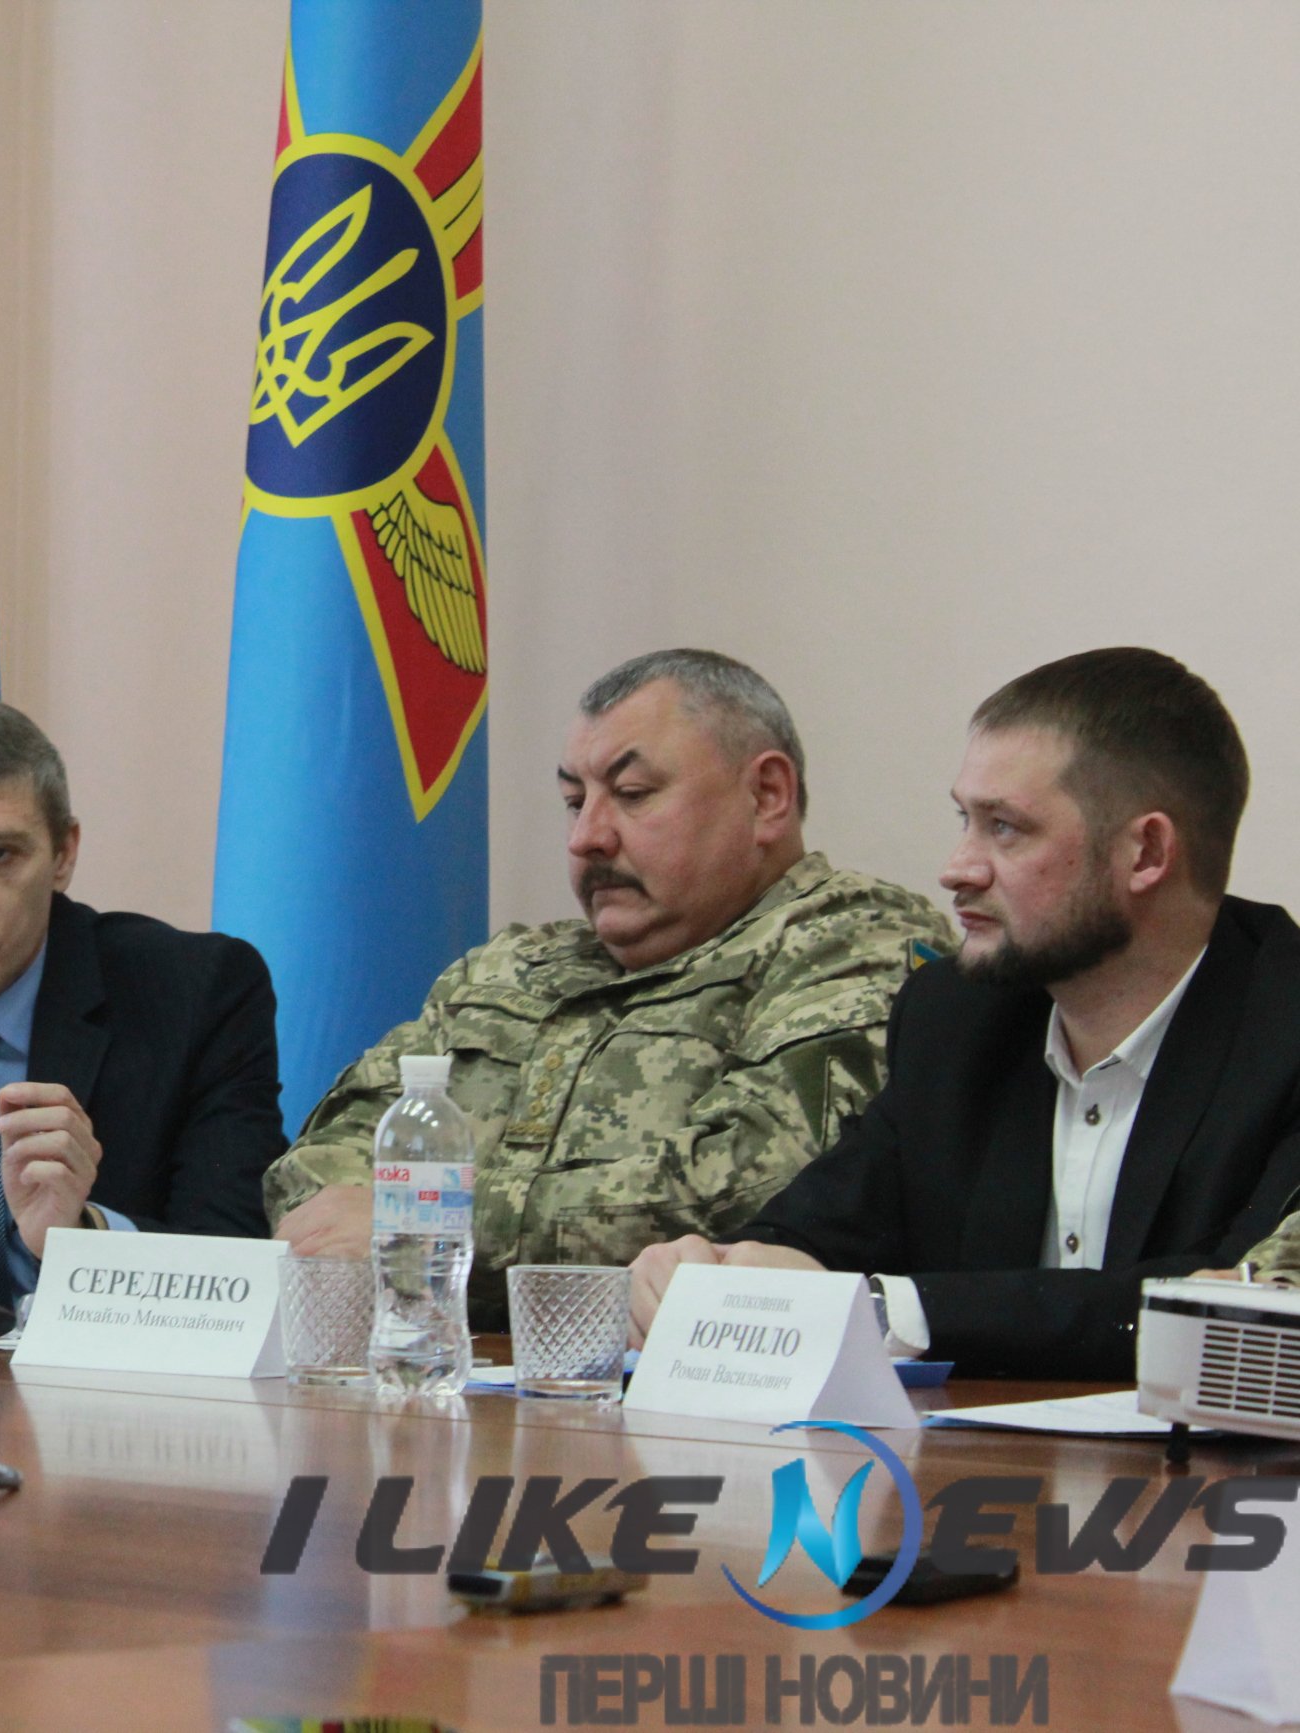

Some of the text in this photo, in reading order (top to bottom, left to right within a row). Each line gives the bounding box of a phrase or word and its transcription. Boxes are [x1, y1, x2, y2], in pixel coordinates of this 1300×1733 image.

[67, 1266, 251, 1304] СЕРЕДЕНКО
[58, 1304, 246, 1333] Михайло Миколайович
[723, 1293, 795, 1314] полковник
[688, 1319, 803, 1358] ЮРЧИЛО
[669, 1359, 793, 1391] Роман Васильович
